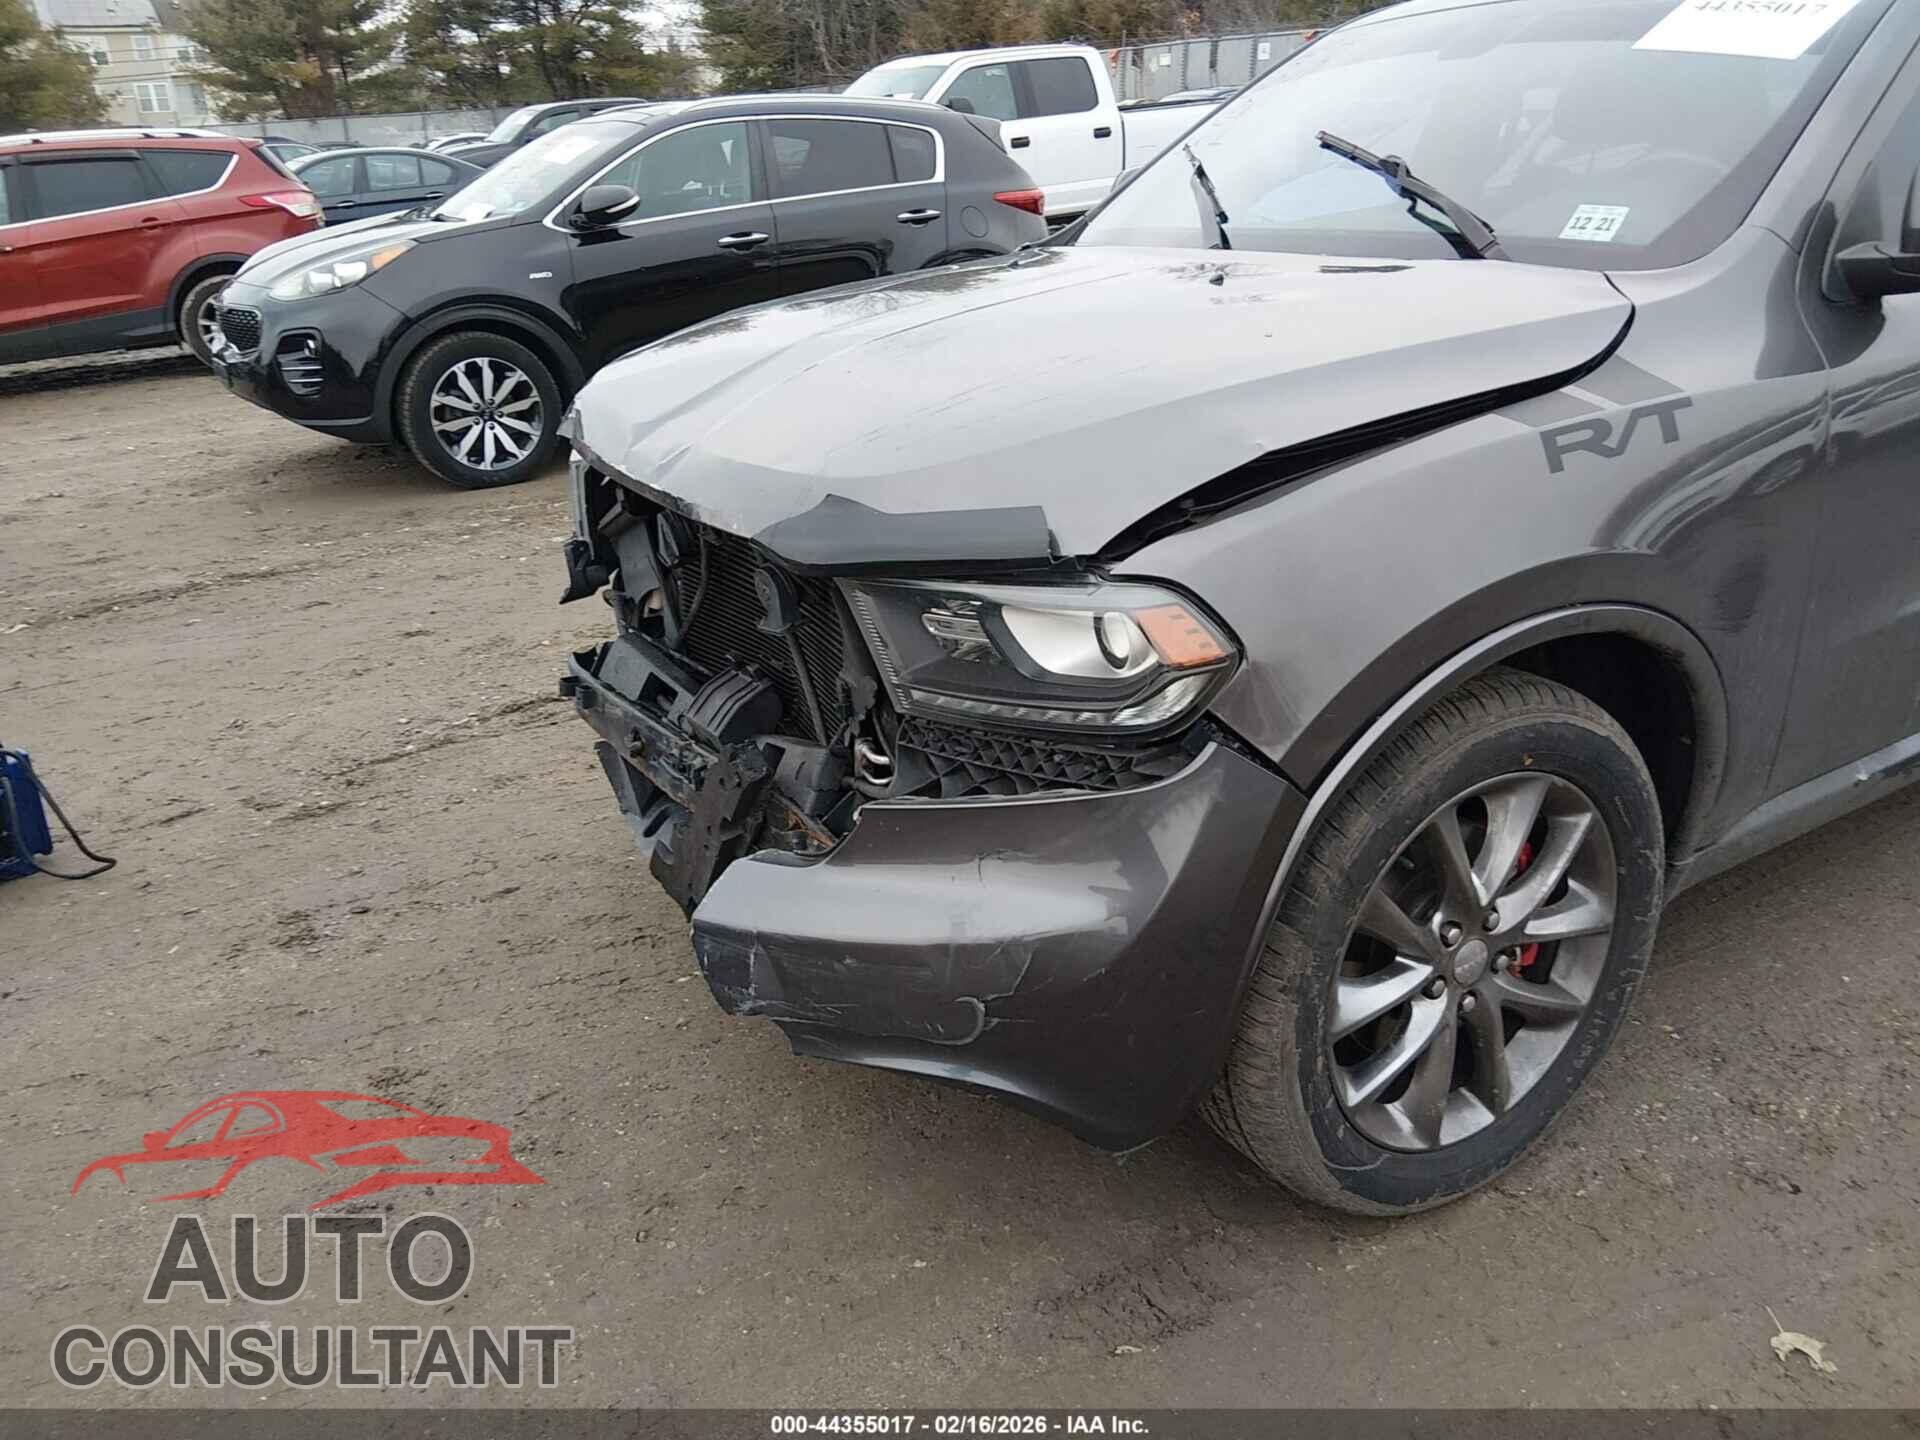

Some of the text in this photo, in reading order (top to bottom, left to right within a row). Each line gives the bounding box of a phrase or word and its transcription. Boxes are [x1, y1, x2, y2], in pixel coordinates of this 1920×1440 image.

[1569, 216, 1617, 231] 12 21
[1539, 396, 1693, 474] R/T
